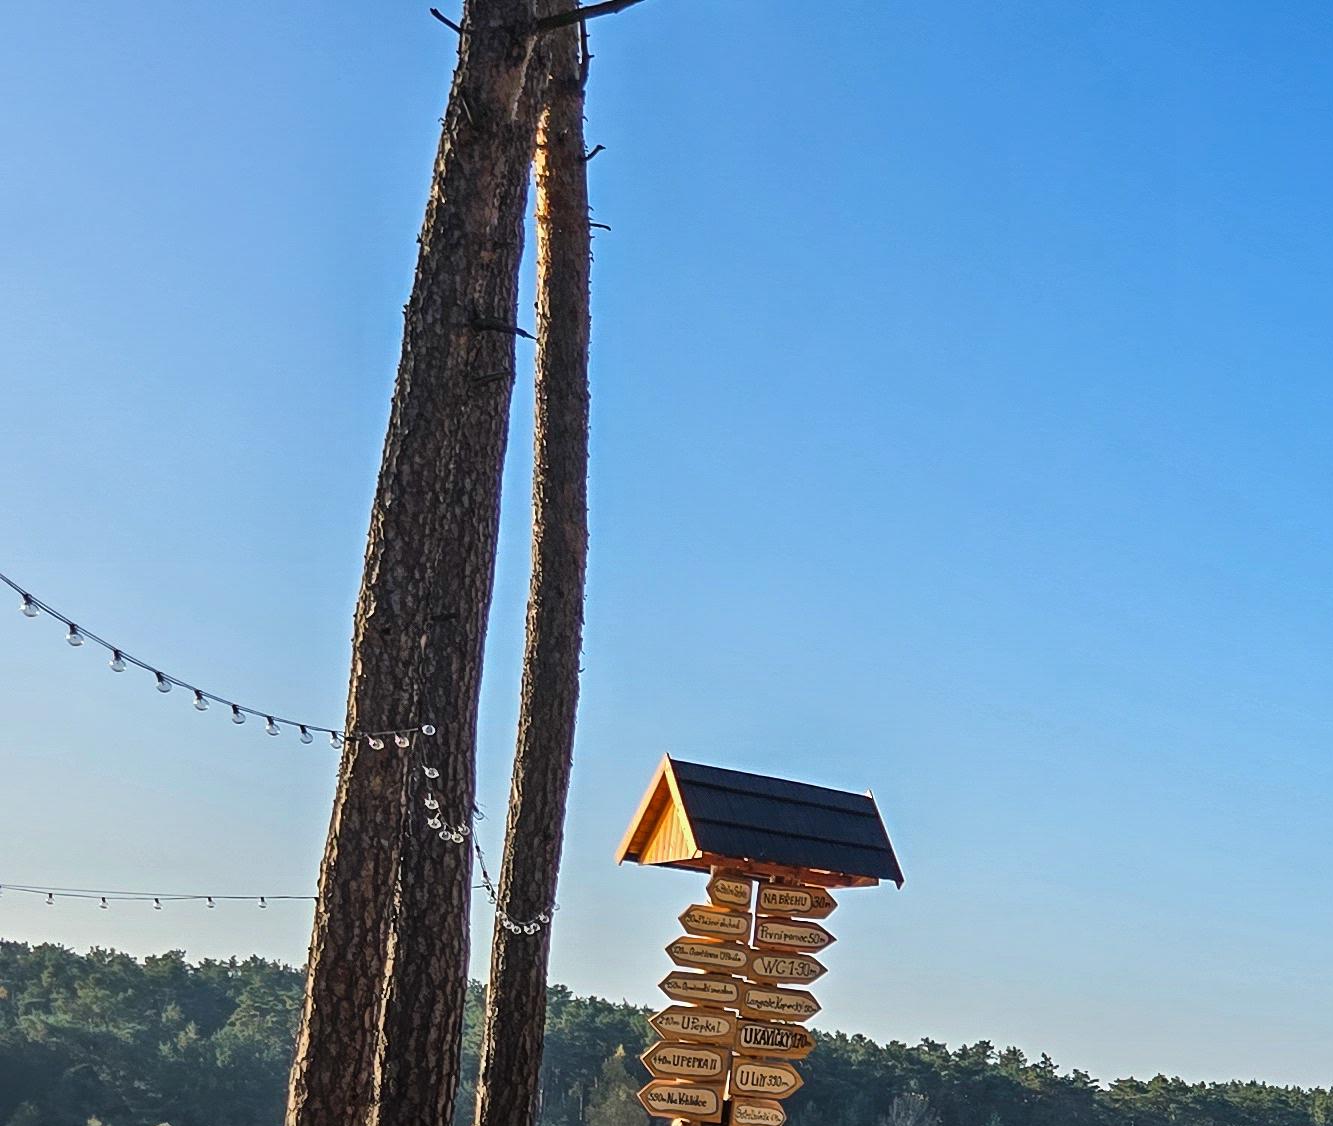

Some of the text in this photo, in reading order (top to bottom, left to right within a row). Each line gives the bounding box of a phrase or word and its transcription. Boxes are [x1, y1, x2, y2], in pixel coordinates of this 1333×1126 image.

[763, 892, 777, 905] NA
[778, 892, 807, 906] BŘEHU
[761, 957, 786, 975] WC
[681, 1015, 690, 1030] U
[740, 1070, 750, 1086] U
